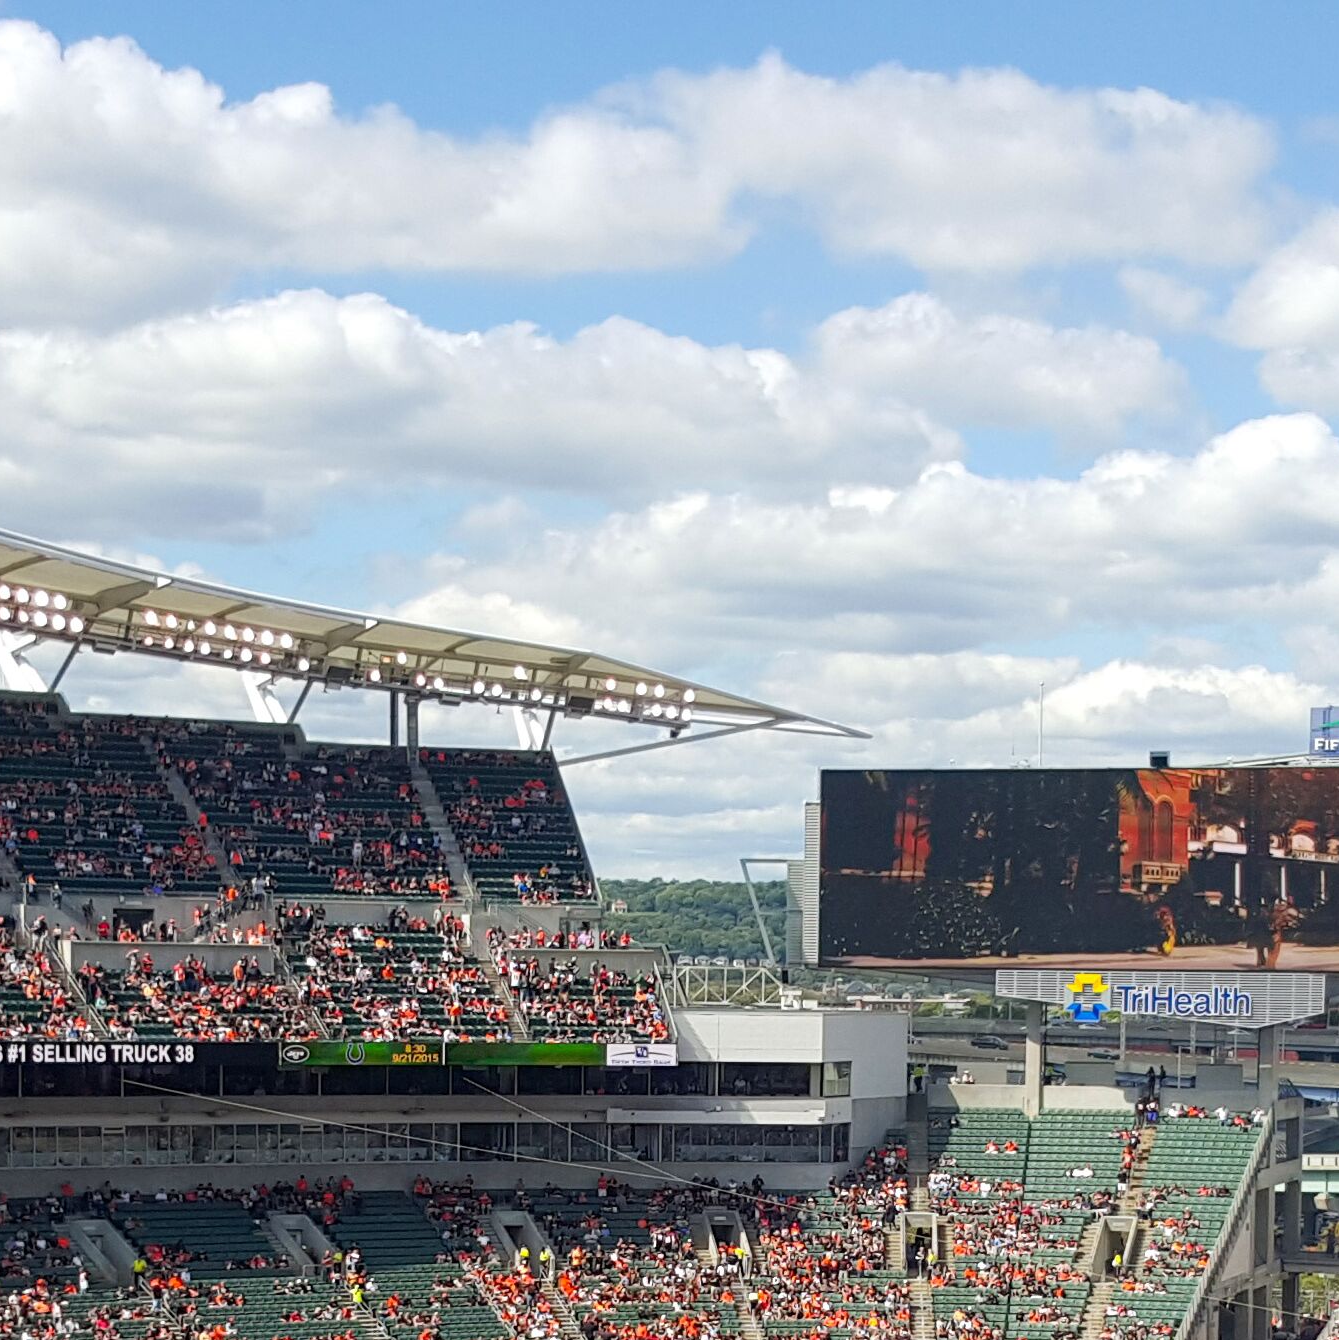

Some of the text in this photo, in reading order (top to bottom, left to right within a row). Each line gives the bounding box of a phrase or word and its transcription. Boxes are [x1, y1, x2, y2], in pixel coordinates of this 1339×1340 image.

[1114, 985, 1253, 1016] TriHealth
[8, 1044, 26, 1063] #1
[32, 1043, 107, 1063] SELLING
[111, 1043, 172, 1063] TRUCK
[175, 1043, 195, 1063] 38
[392, 1053, 439, 1063] 9/21/2015
